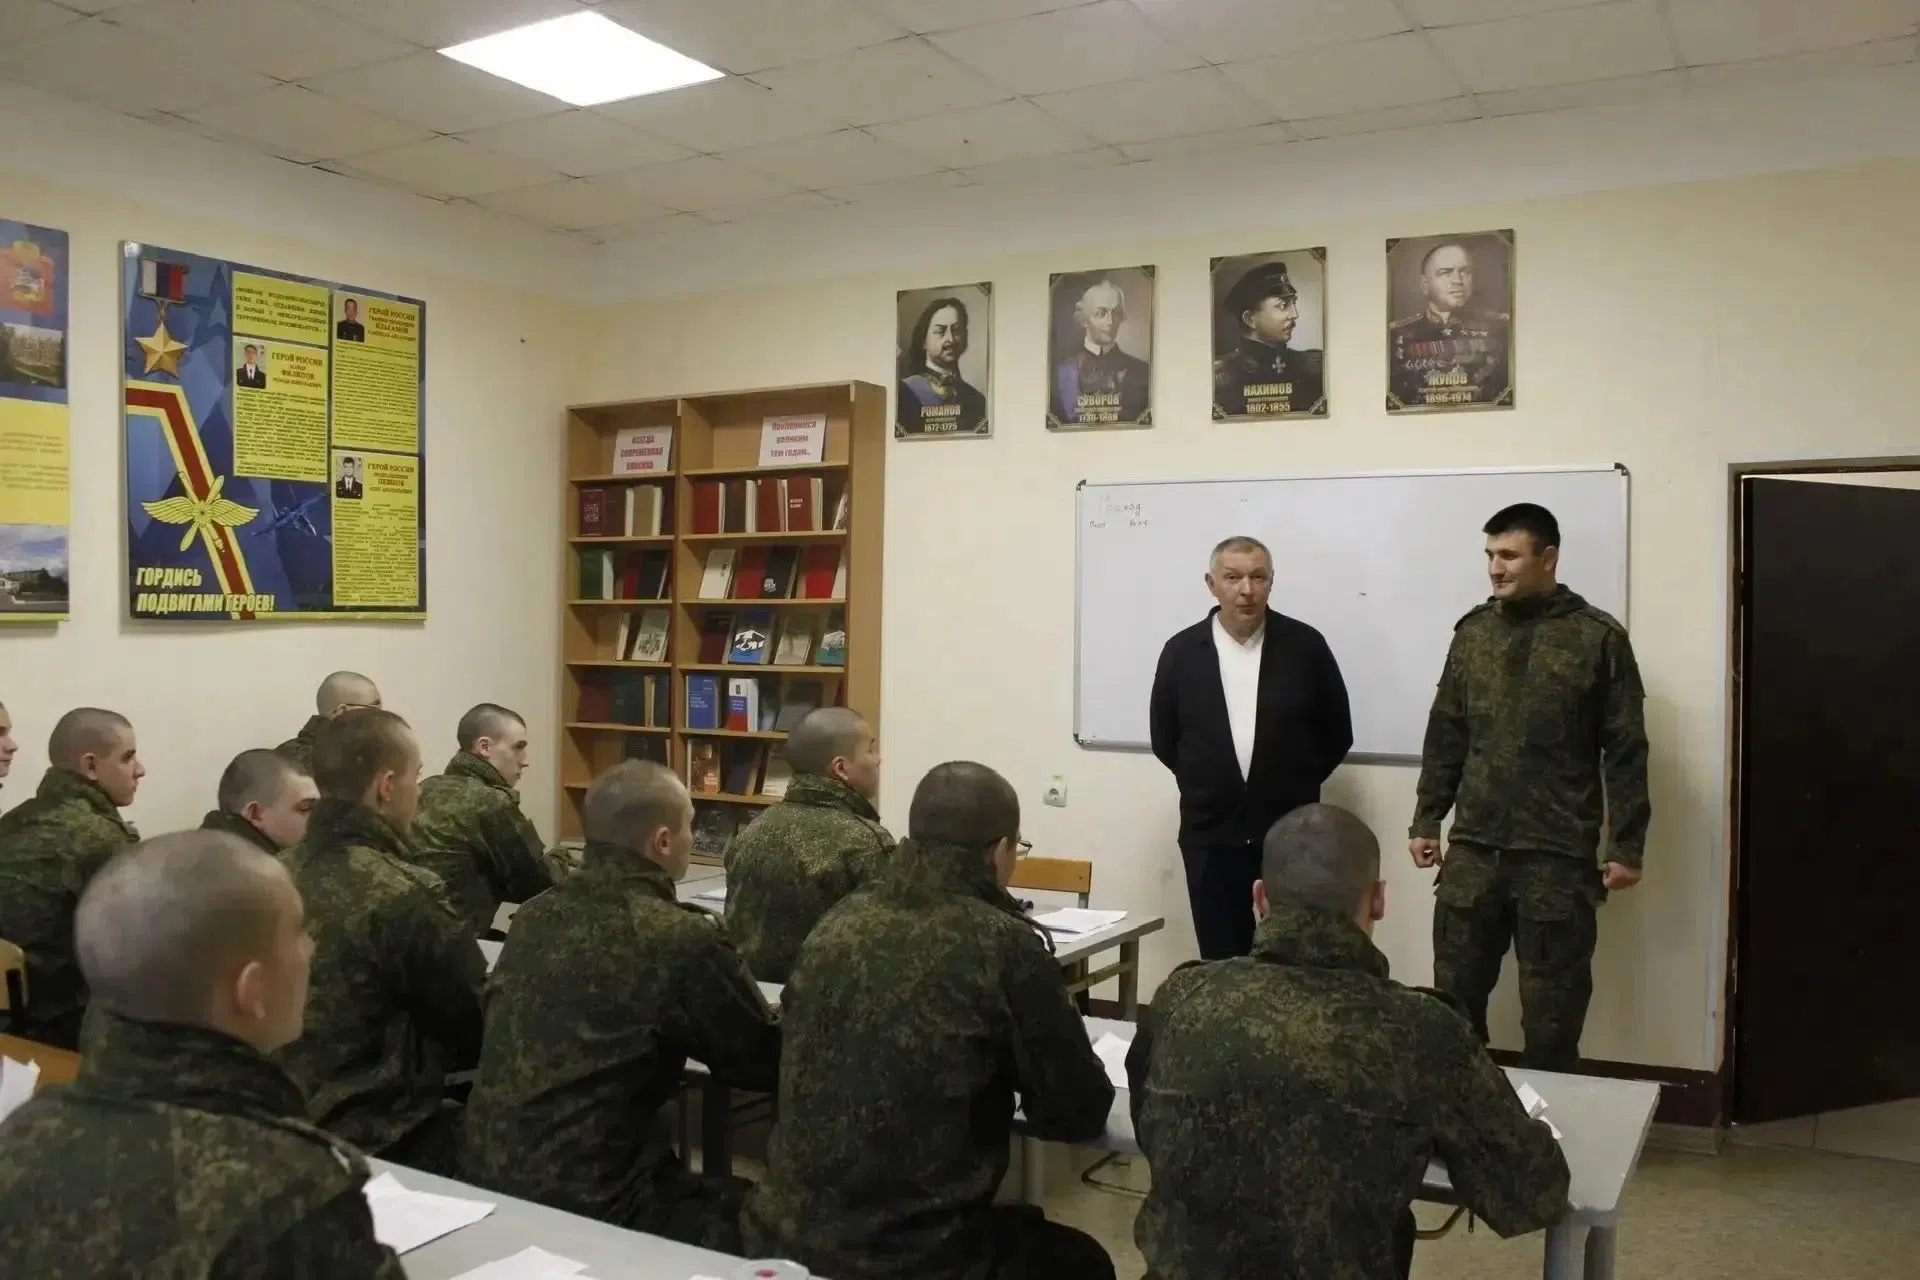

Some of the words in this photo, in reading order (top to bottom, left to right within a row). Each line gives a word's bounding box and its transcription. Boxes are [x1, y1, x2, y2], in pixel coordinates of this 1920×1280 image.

[368, 307, 389, 316] ГЕРОЙ
[391, 311, 415, 321] РОССИИ
[272, 352, 294, 362] ГЕРОЙ
[296, 356, 323, 366] РОССИИ
[1429, 372, 1468, 385] ЖУКОВ
[1243, 382, 1293, 396] НАХИМОВ
[921, 404, 961, 417] РОМАНОВ
[1246, 402, 1291, 413] 1802-1855
[136, 567, 202, 588] ГОРДИСЬ
[136, 593, 224, 614] ПОДВИГАМИ
[225, 594, 275, 612] ГЕРОЕВ!
